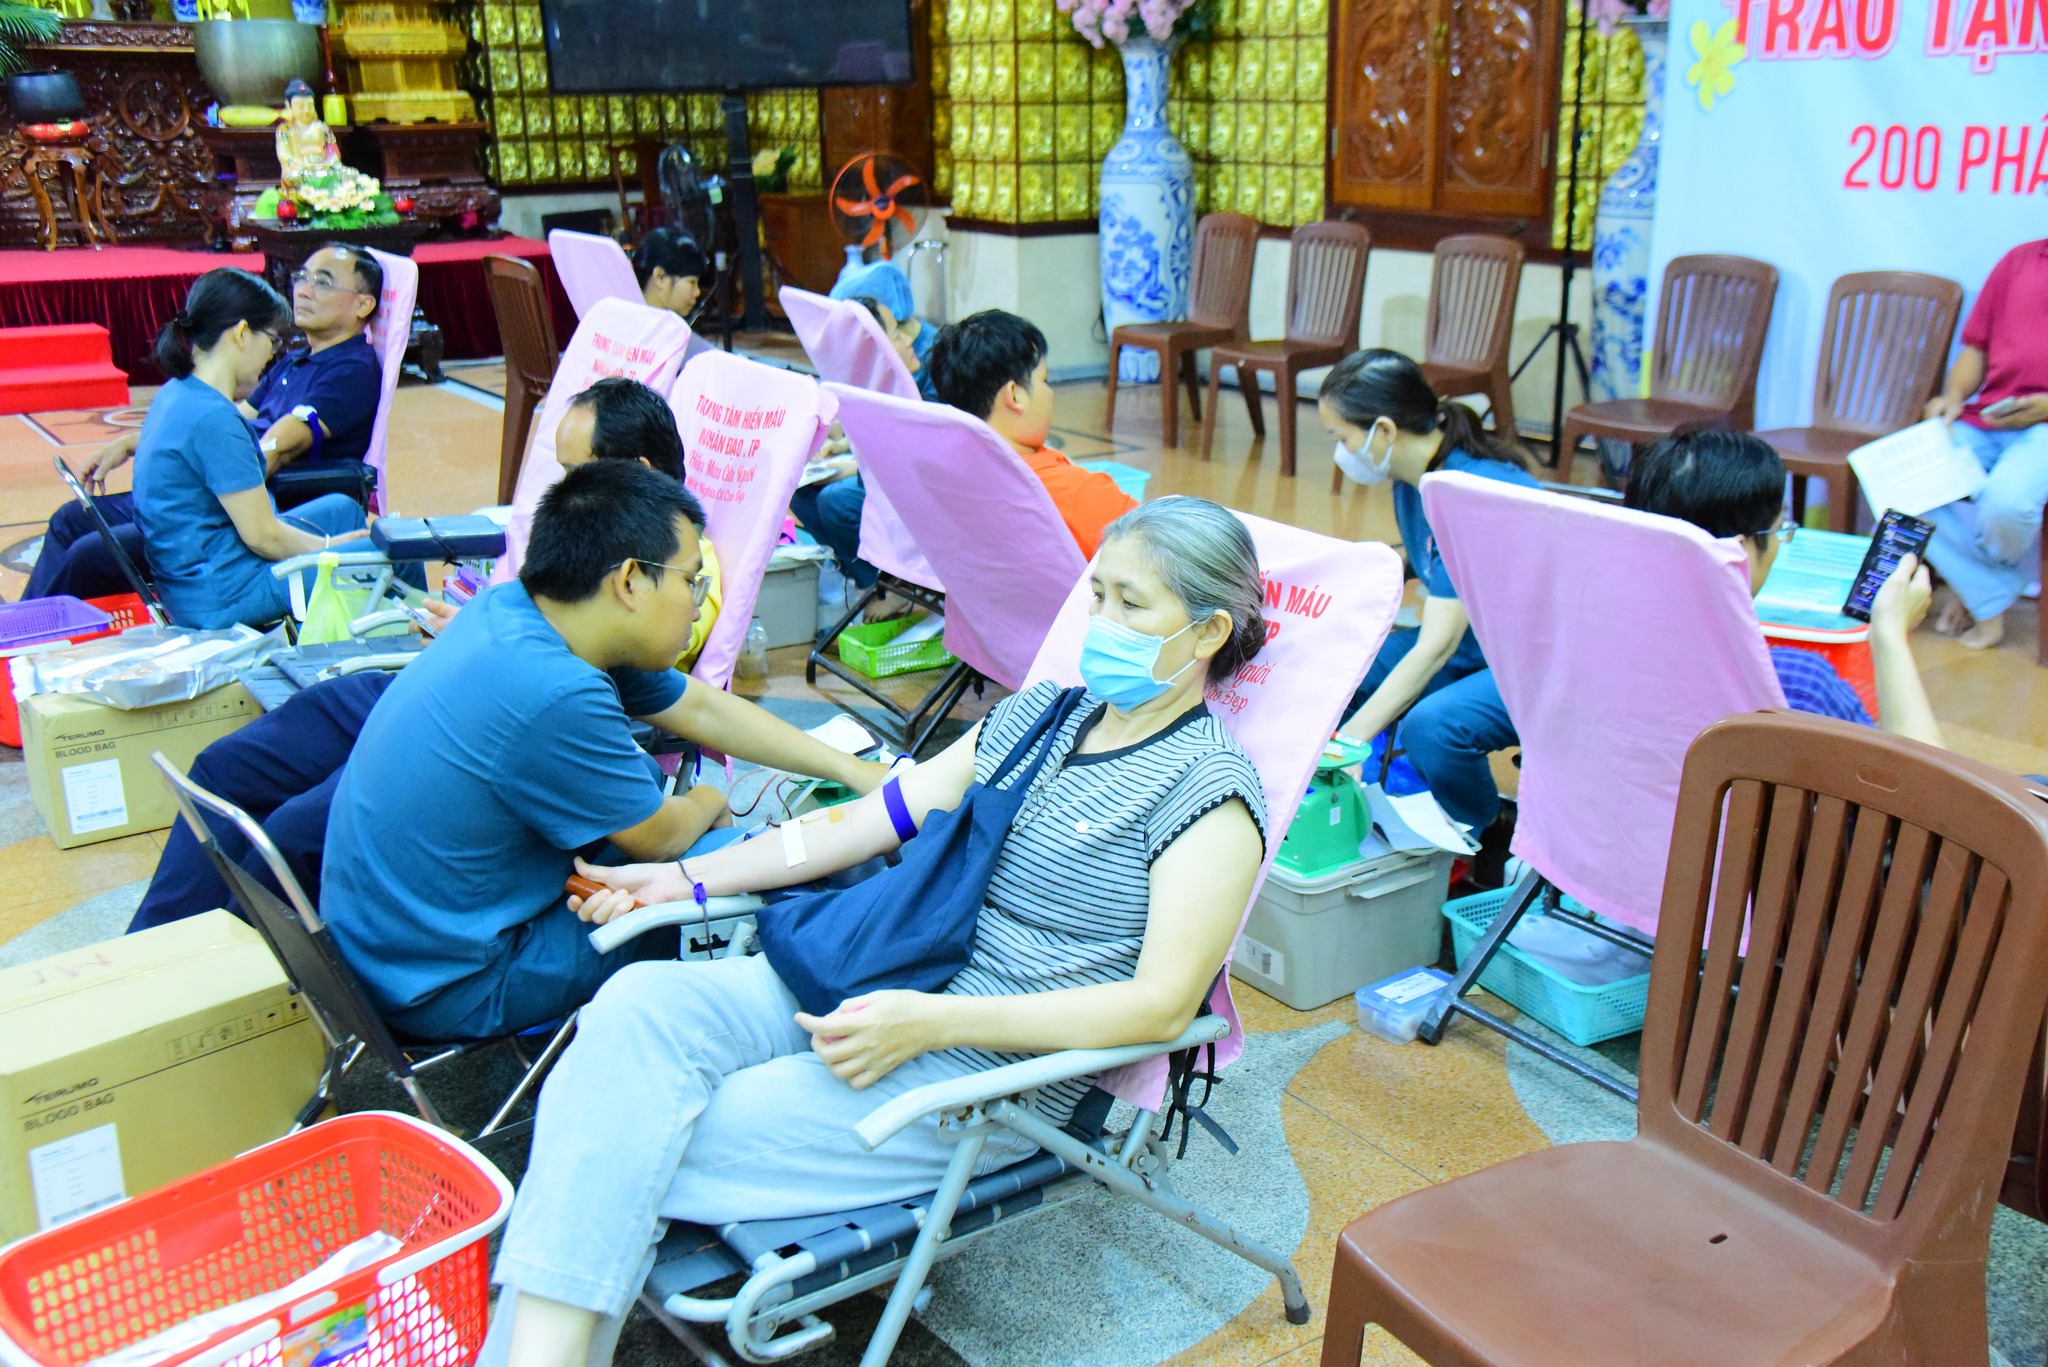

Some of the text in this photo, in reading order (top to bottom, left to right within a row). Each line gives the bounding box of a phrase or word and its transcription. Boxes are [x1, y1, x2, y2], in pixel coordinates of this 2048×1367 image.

[1844, 125, 1941, 191] 200
[722, 404, 742, 428] TÂM
[741, 406, 764, 430] HIẾN
[762, 406, 787, 430] MÁU
[748, 438, 761, 458] TP
[1284, 584, 1333, 619] MÁU
[1221, 689, 1249, 715] Đẹp
[56, 729, 105, 741] TERUMO
[55, 741, 117, 759] BLOOD BAG
[26, 1076, 100, 1105] TERUMO
[24, 1092, 116, 1132] BLOOD BAG
